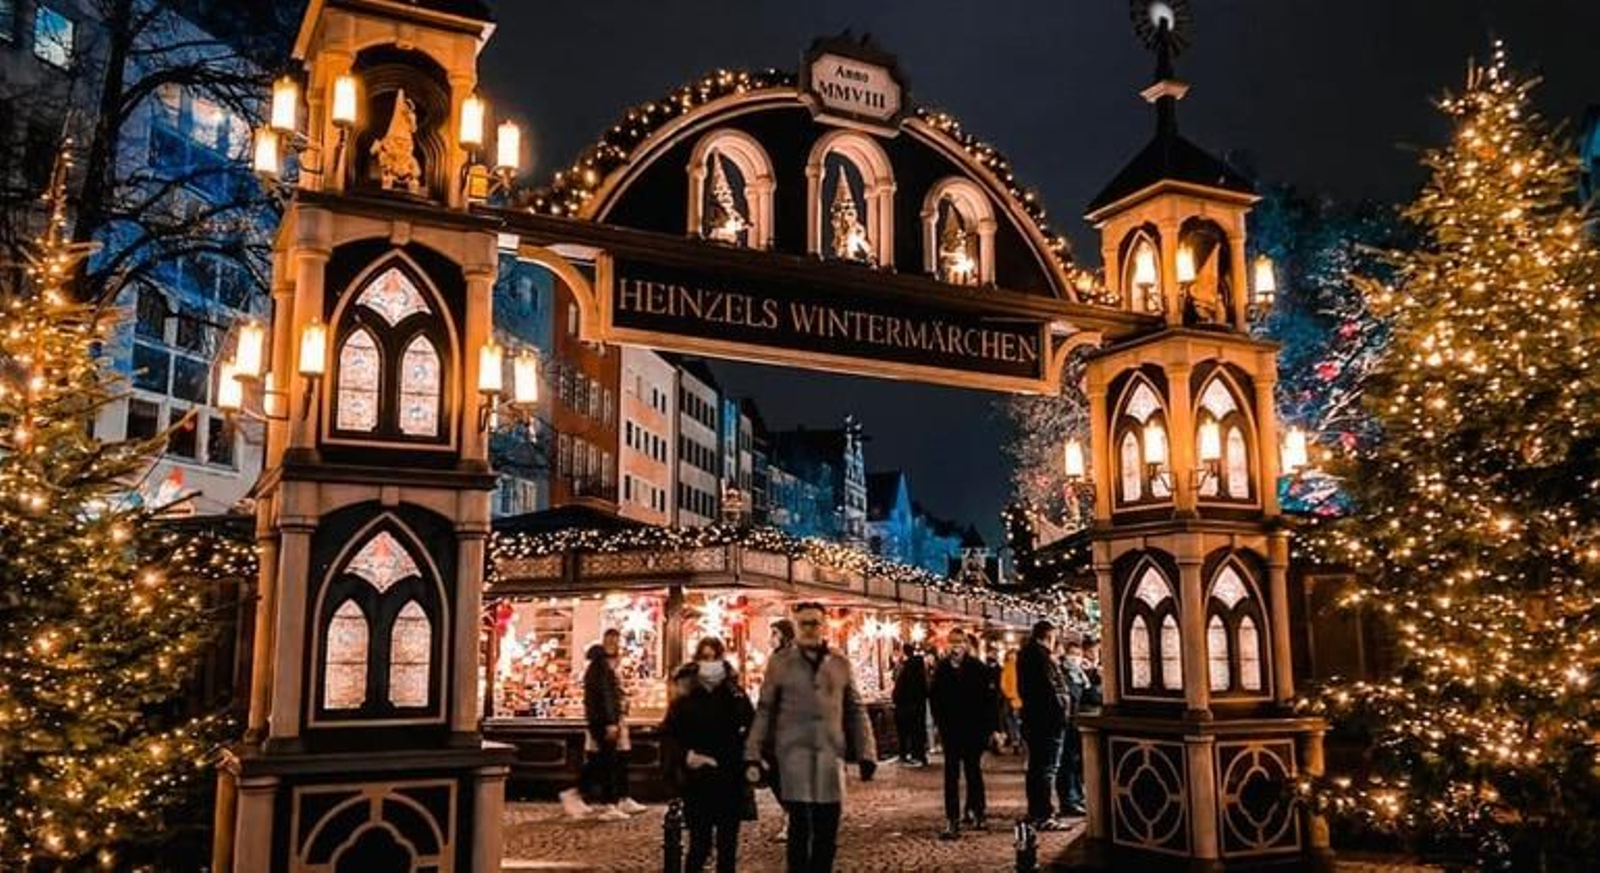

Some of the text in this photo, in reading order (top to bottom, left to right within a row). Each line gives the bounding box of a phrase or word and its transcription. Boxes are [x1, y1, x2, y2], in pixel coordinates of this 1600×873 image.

[835, 65, 869, 83] Anno
[820, 80, 885, 108] MMVIII
[618, 278, 1037, 363] HEINZELS WINTERMÄRCHEN
